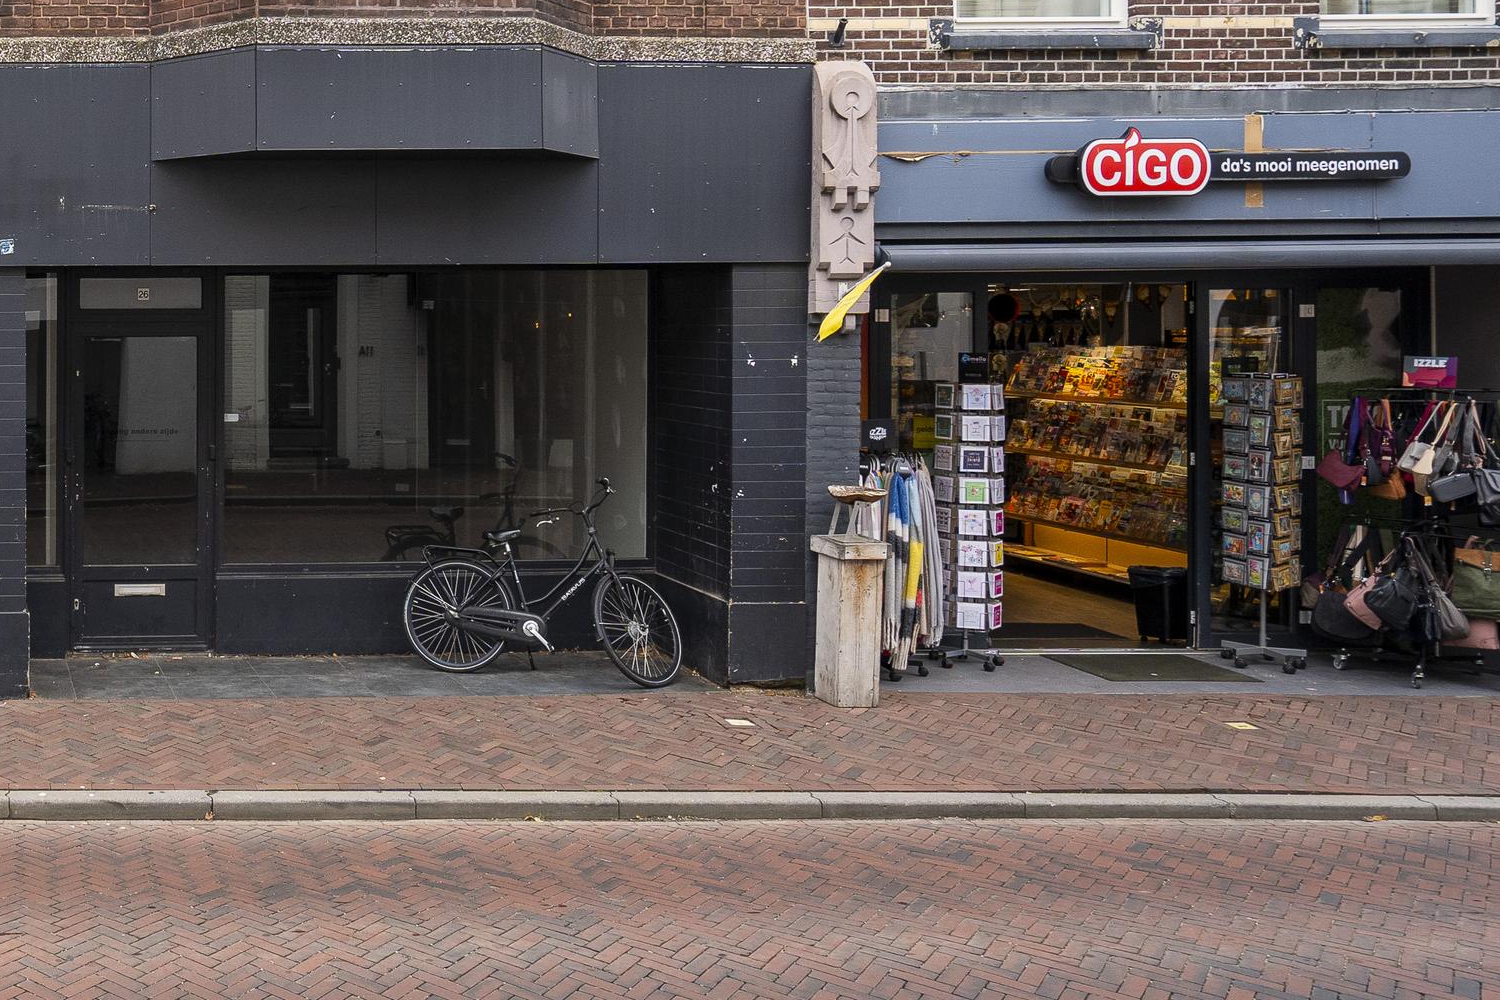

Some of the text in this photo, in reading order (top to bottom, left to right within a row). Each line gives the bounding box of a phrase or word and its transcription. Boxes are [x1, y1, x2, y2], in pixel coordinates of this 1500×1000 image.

[1092, 142, 1202, 187] CIGO
[1221, 158, 1399, 175] da's mooi meegenomen
[138, 290, 149, 299] 26
[1413, 358, 1448, 368] IZZLE
[561, 577, 586, 601] BATAVUS
